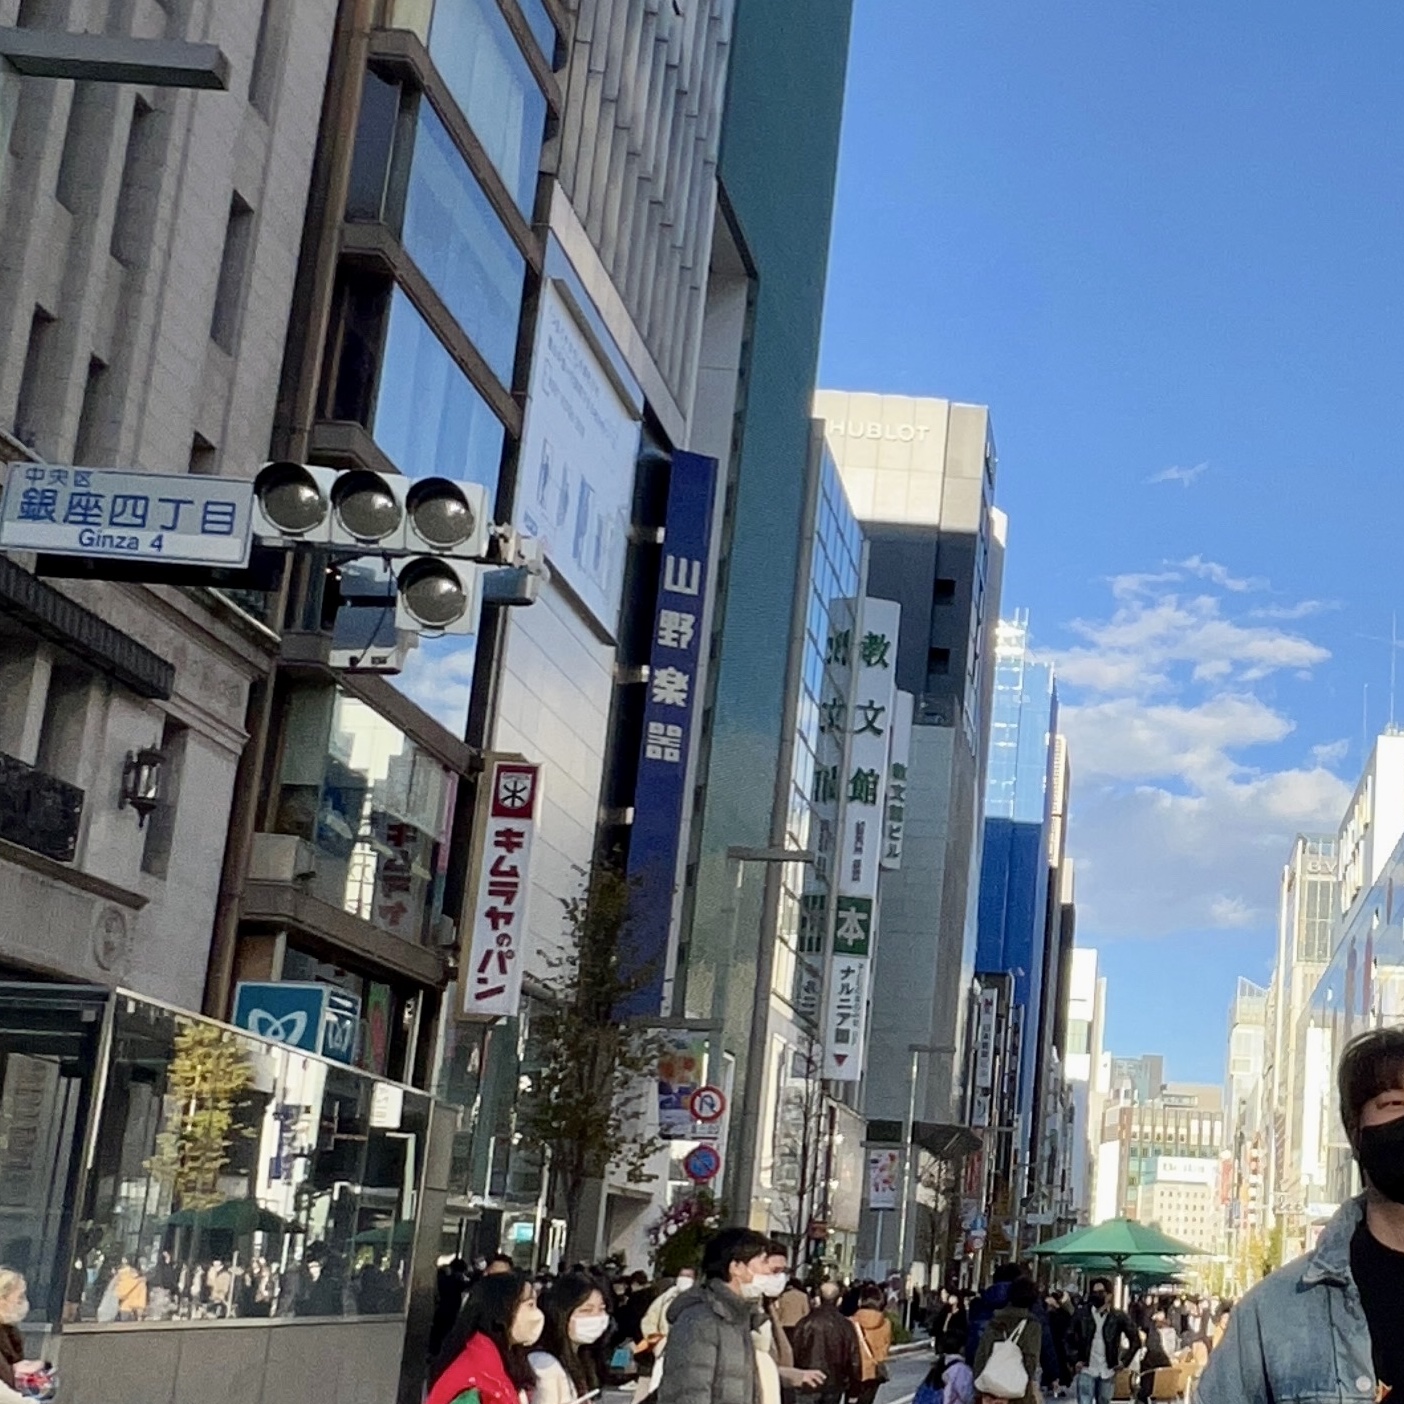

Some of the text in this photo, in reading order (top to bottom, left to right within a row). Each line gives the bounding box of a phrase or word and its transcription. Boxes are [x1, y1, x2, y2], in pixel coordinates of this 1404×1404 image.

[829, 419, 930, 442] HUBLOT
[25, 467, 93, 488] 中央区
[17, 487, 236, 535] 銀座四丁目
[79, 528, 164, 551] Ginza 4
[645, 555, 701, 763] 山野楽器
[847, 631, 891, 805] 教文館
[475, 828, 525, 1000] キムラヤのパン
[836, 906, 869, 946] 本
